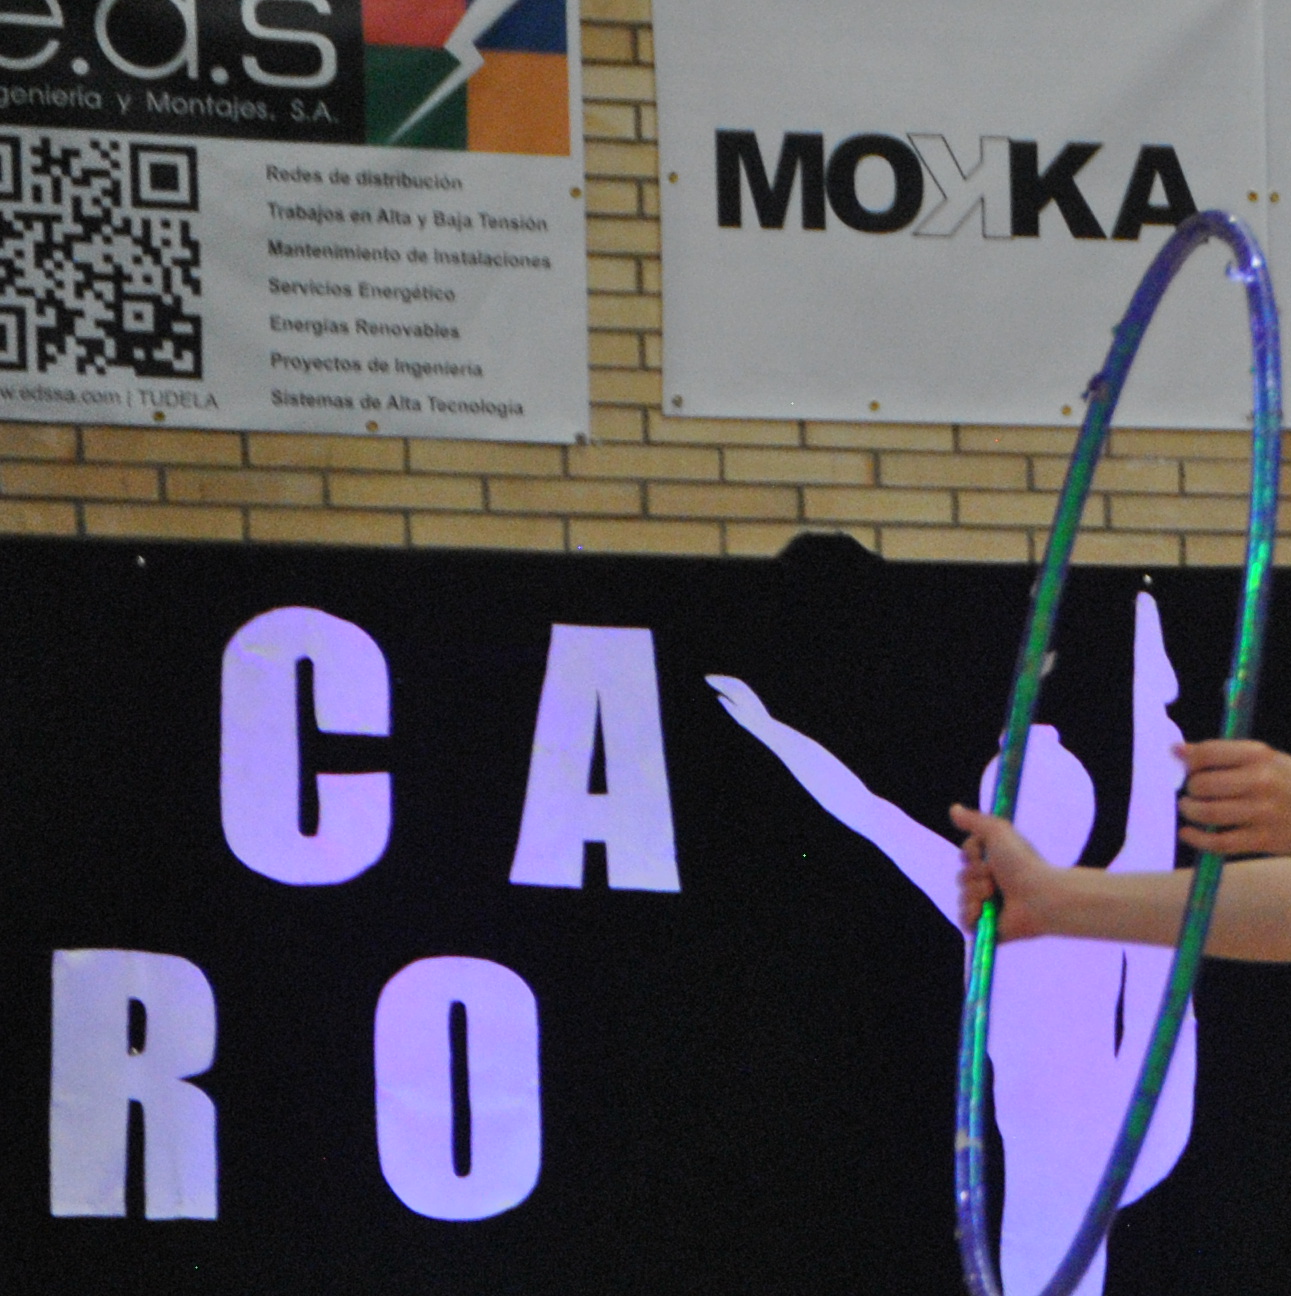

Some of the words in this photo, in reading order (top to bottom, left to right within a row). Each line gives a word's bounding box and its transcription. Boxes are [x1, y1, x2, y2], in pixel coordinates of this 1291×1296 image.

[117, 93, 131, 115] y
[290, 98, 339, 123] S.A.
[266, 165, 323, 185] Redes
[329, 168, 350, 186] de
[356, 169, 463, 191] distribución
[267, 202, 345, 226] Trabajos
[350, 211, 372, 225] en
[377, 208, 411, 226] Alta
[416, 214, 428, 230] y
[433, 210, 473, 232] Baja
[478, 211, 548, 232] Tensión
[267, 239, 401, 262] Mantenimiento
[407, 247, 428, 263] de
[268, 277, 353, 298] Servicios
[358, 281, 456, 303] Energético
[269, 314, 349, 337] Energías
[355, 318, 460, 339] Renovables
[270, 352, 361, 373] Proyectos
[368, 357, 389, 373] de
[138, 388, 219, 410] TUDELA
[271, 389, 353, 409] Sistemas
[360, 393, 382, 411] de
[386, 395, 422, 412] Alta
